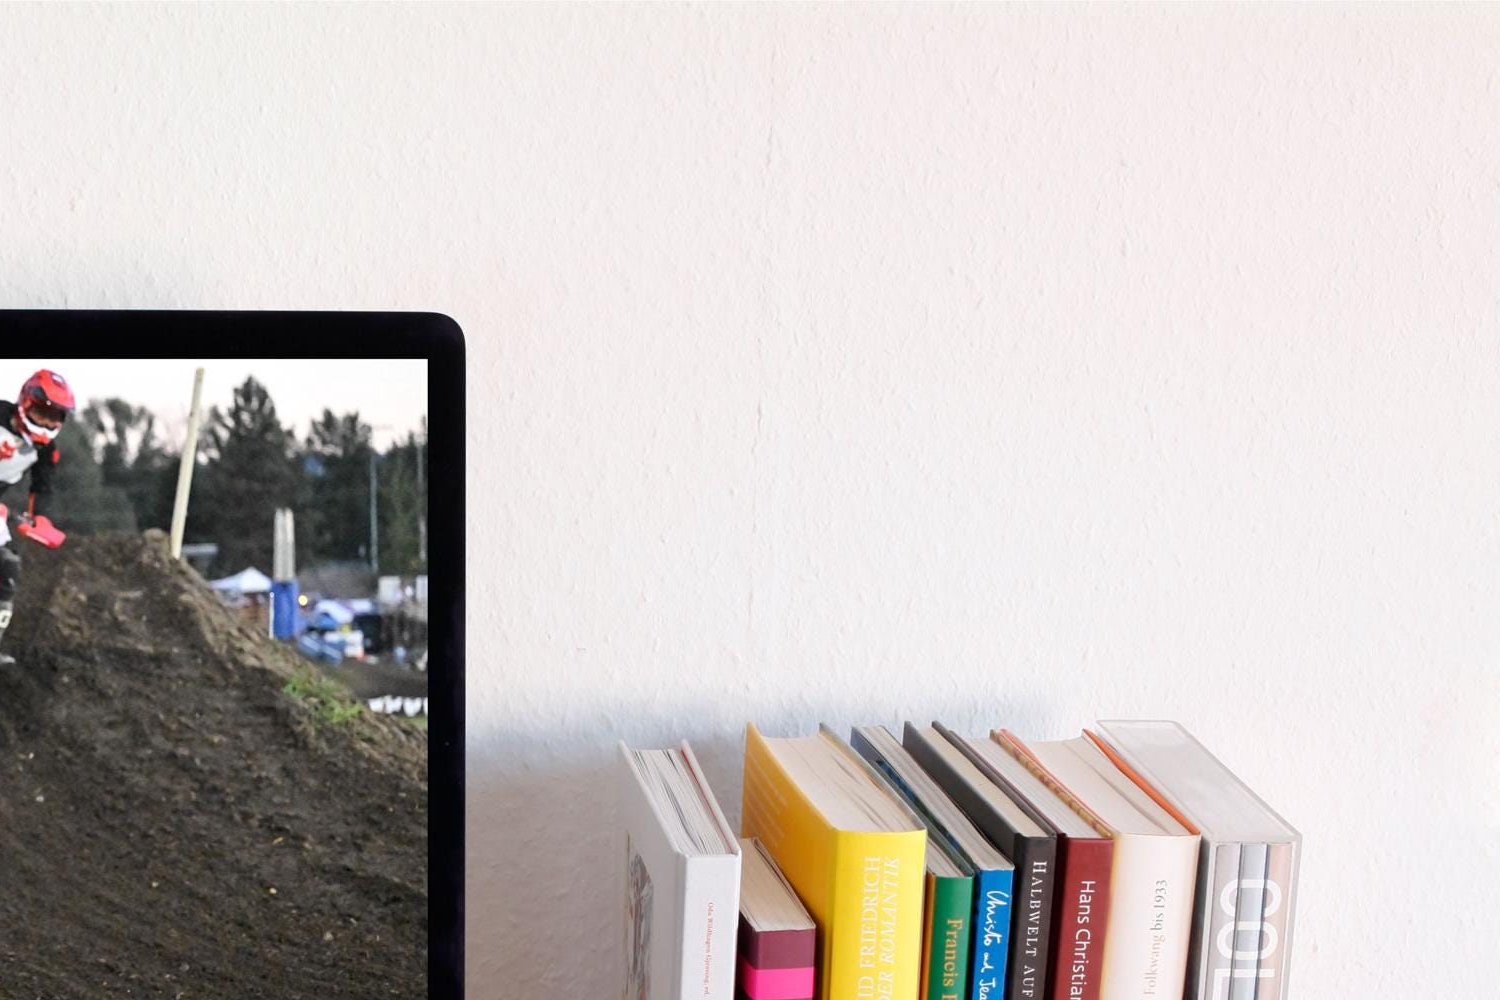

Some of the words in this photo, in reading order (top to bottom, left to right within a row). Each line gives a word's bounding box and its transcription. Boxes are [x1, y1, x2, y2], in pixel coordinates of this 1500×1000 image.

[859, 855, 881, 969] FRIEDRICH
[879, 856, 900, 966] ROMANTIK
[1024, 860, 1048, 957] HALBWELT
[1076, 880, 1096, 925] Hans
[1150, 911, 1164, 932] bis
[1153, 879, 1168, 910] 1933
[942, 918, 963, 988] Francis
[1019, 965, 1035, 998] AUF
[1143, 935, 1166, 997] Folkwang
